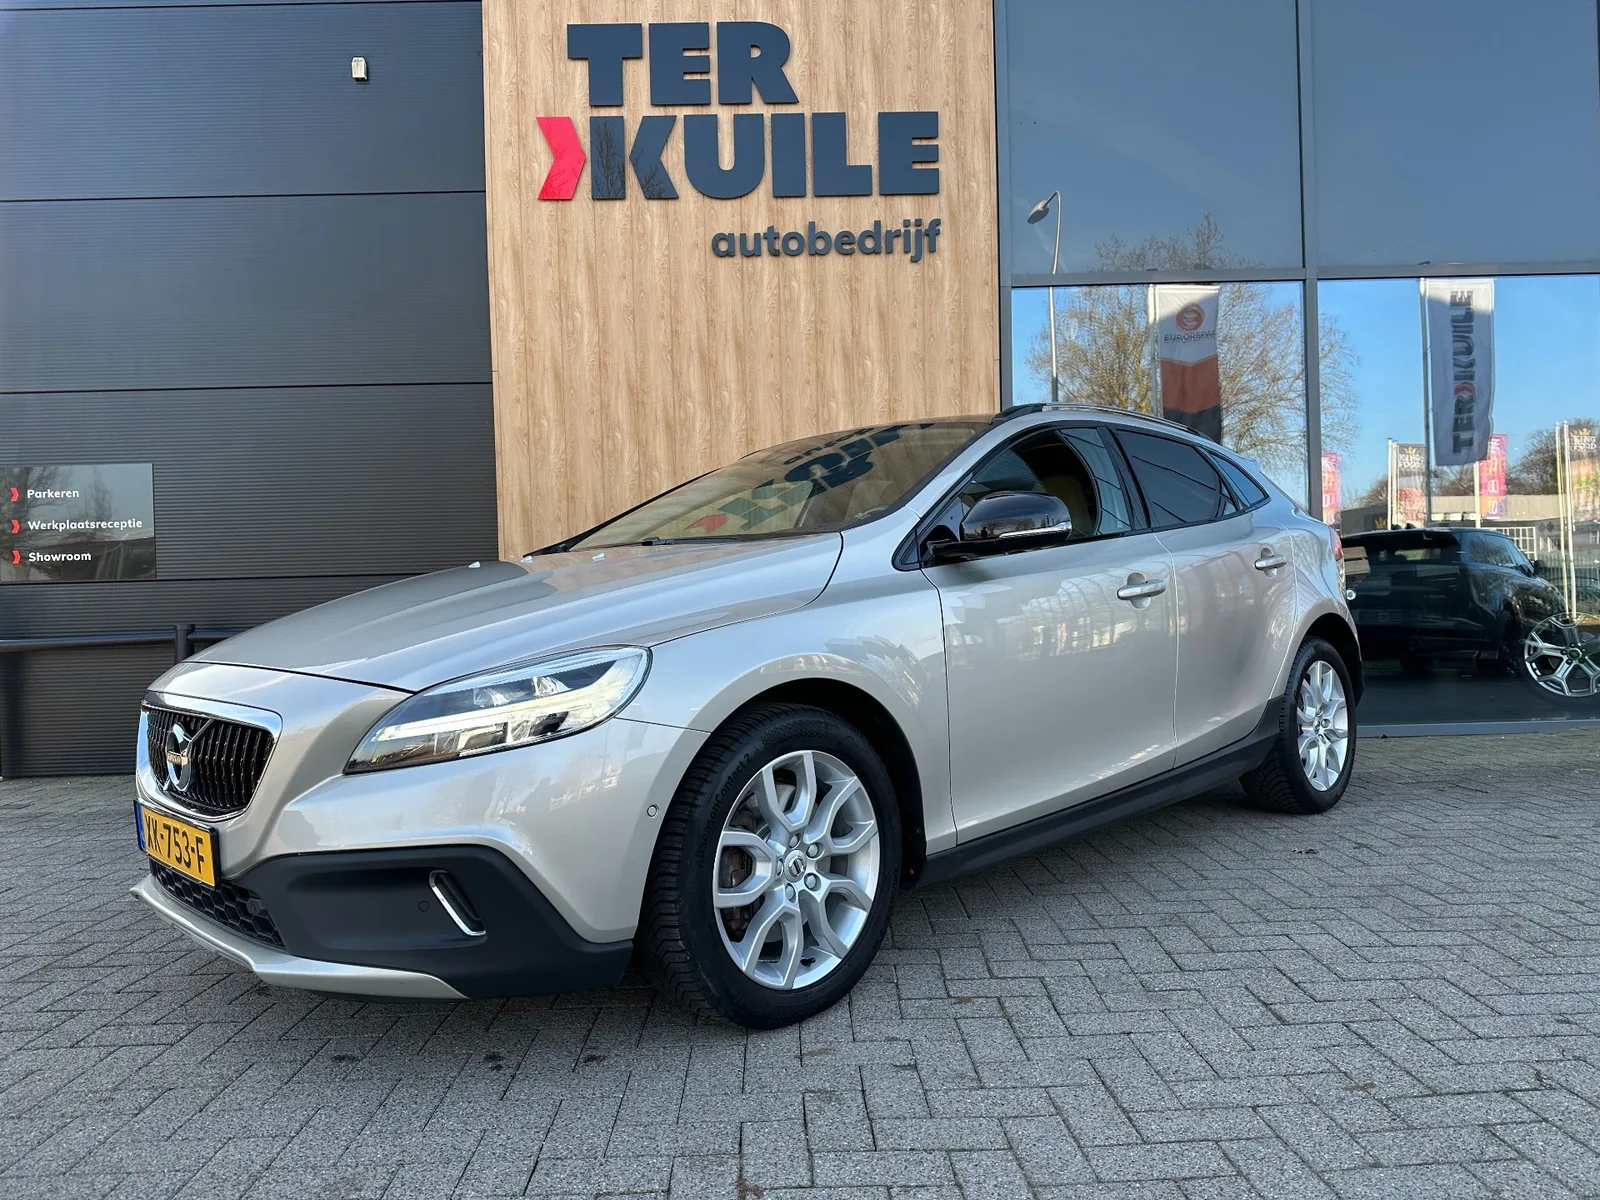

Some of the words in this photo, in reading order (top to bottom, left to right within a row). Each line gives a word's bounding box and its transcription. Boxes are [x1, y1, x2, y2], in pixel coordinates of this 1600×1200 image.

[566, 21, 800, 106] TER
[589, 111, 940, 201] KUILE
[711, 218, 942, 263] autobedrijf
[1450, 290, 1476, 381] KUILE
[1452, 396, 1474, 453] TER
[26, 489, 80, 499] Parkeren
[27, 518, 143, 532] Werkplaatsreceptie
[28, 552, 92, 562] Showroom
[144, 813, 205, 874] XK-753-F
